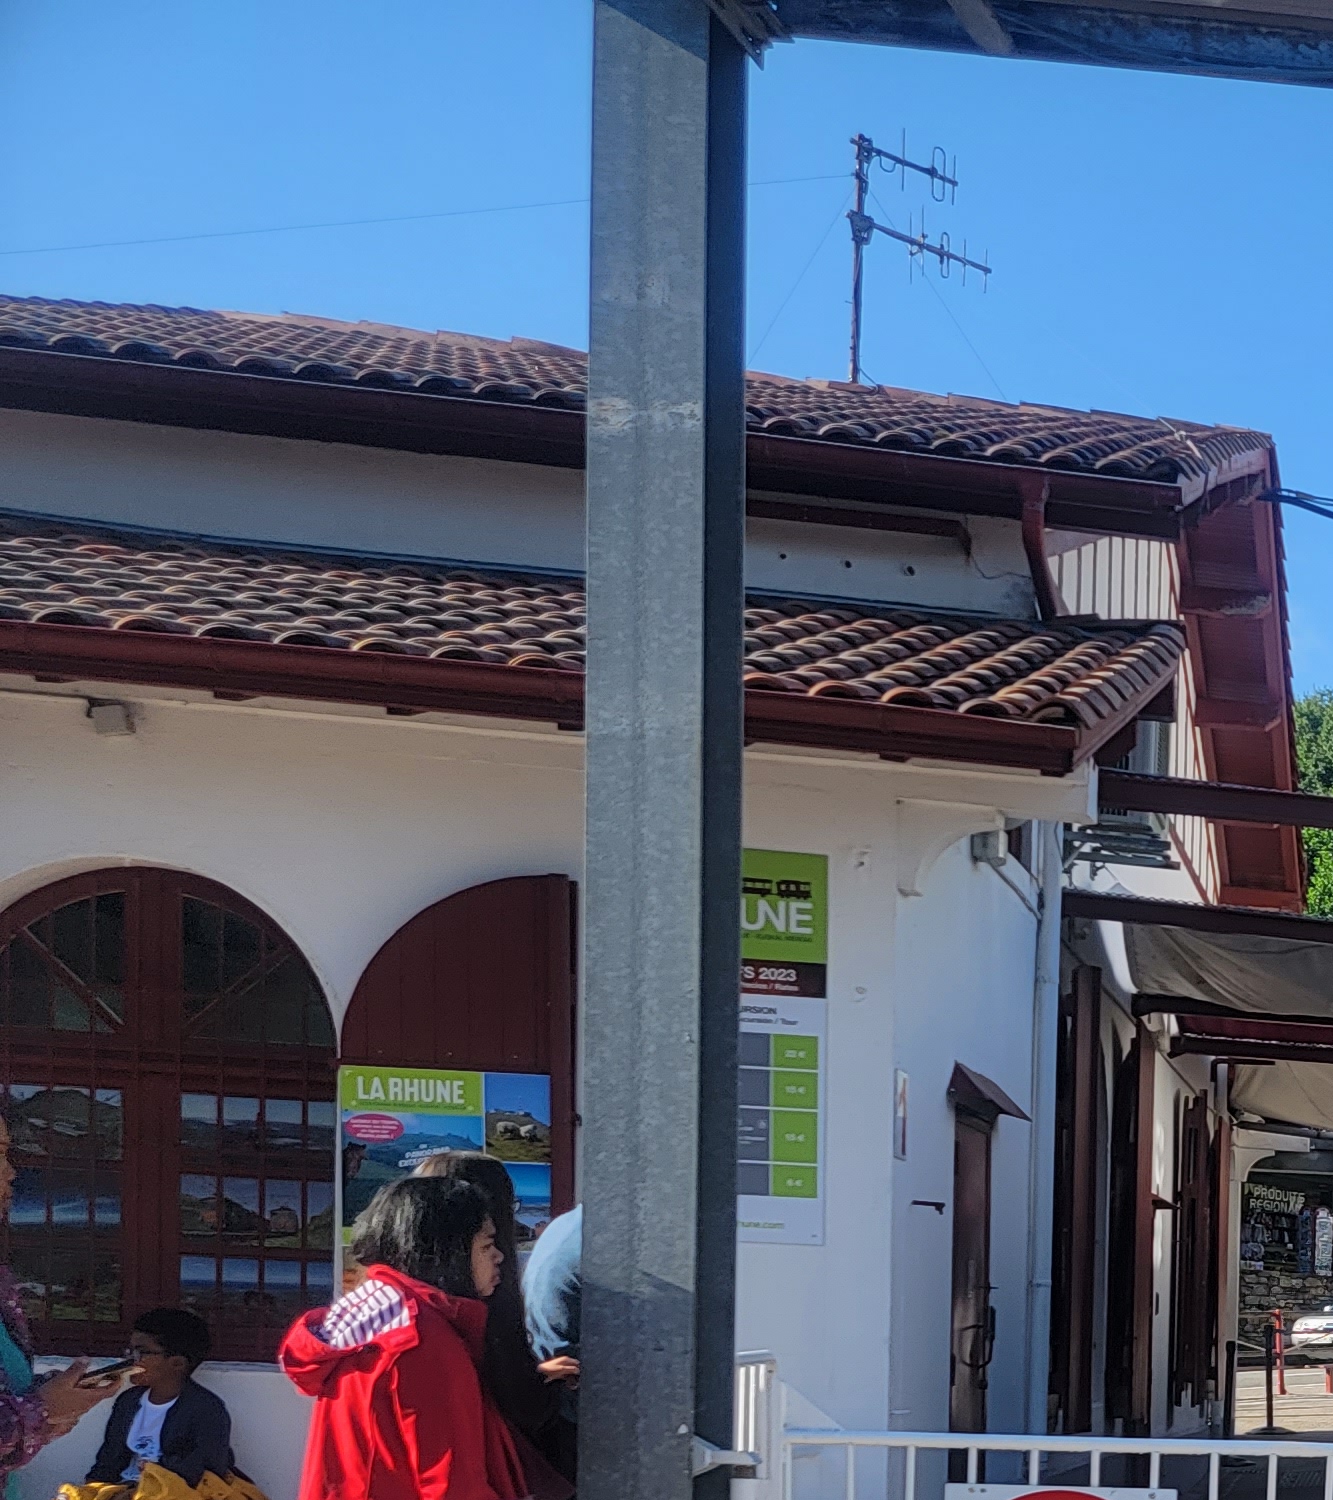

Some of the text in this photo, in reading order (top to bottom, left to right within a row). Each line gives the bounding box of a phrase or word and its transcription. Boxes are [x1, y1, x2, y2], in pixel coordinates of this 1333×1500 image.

[740, 897, 814, 934] UNE
[758, 967, 797, 981] 2023
[356, 1075, 465, 1104] LA RHUNE
